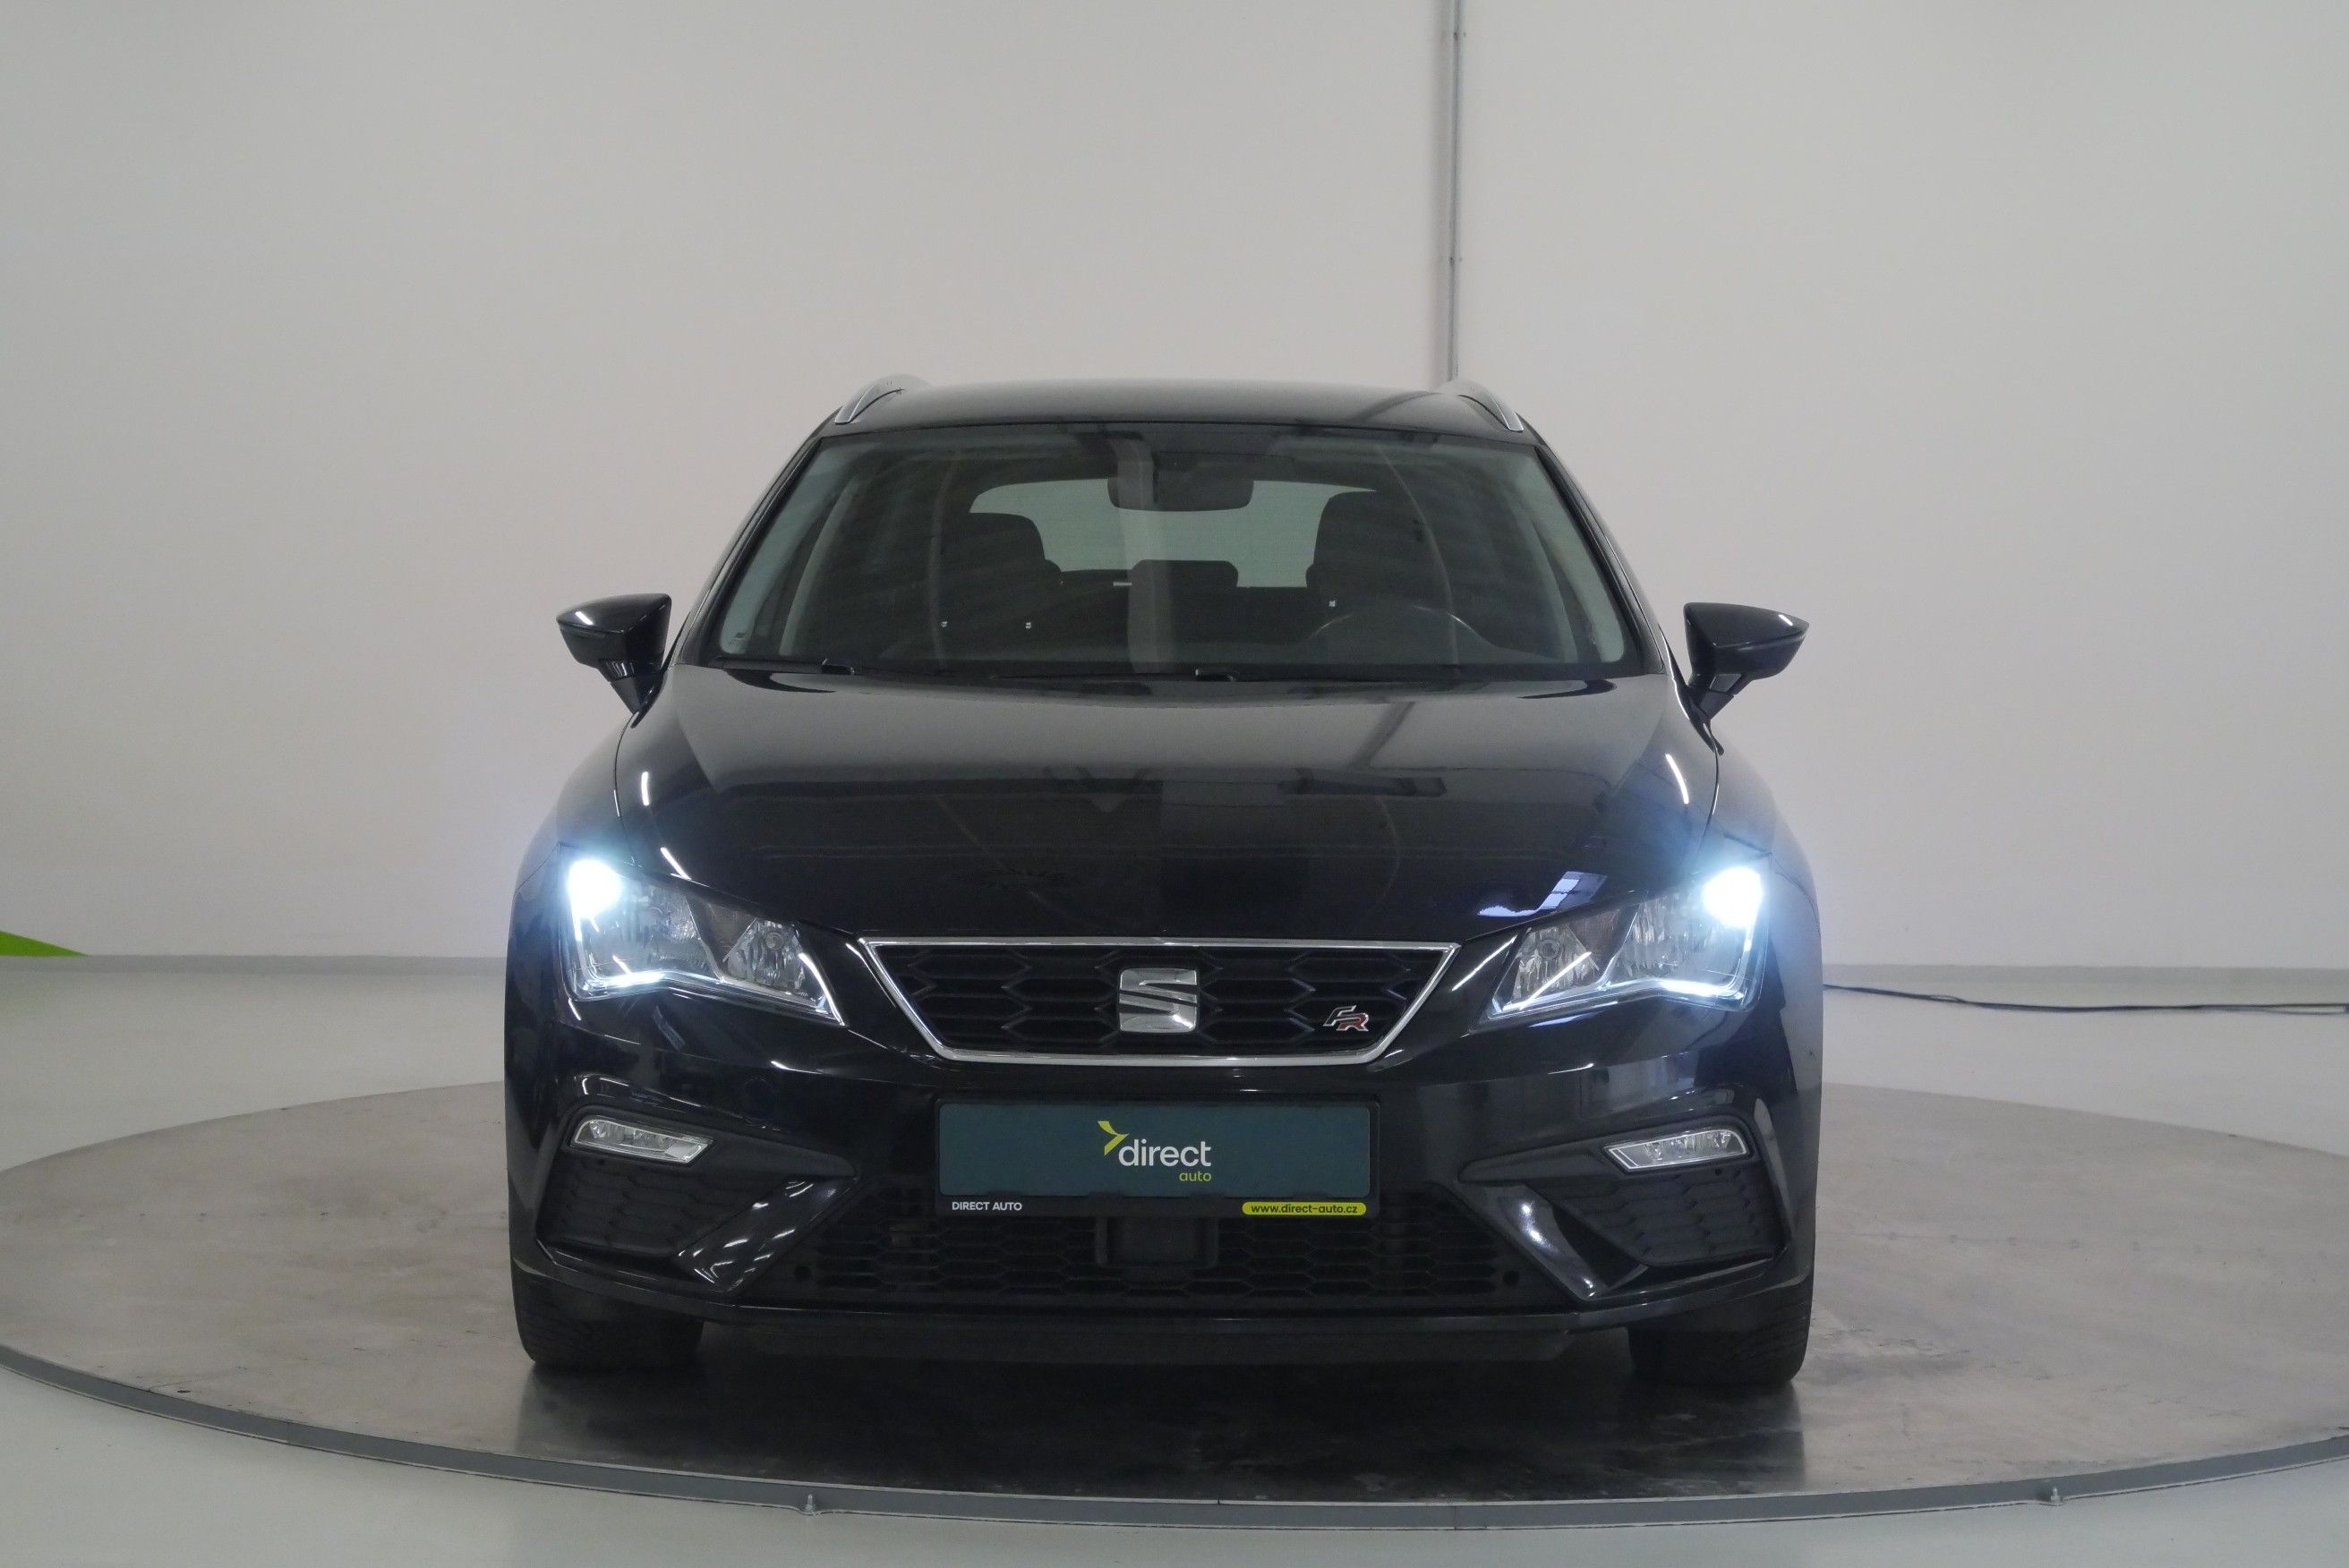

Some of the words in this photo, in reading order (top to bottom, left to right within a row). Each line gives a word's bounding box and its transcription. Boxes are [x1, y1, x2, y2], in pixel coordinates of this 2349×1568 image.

[1322, 1004, 1370, 1032] FR
[1118, 1138, 1212, 1167] direct
[1179, 1171, 1212, 1182] auto
[952, 1201, 990, 1211] DIRECT
[992, 1201, 1022, 1211] AUTO
[1251, 1204, 1358, 1214] www.direct-auto.cz
